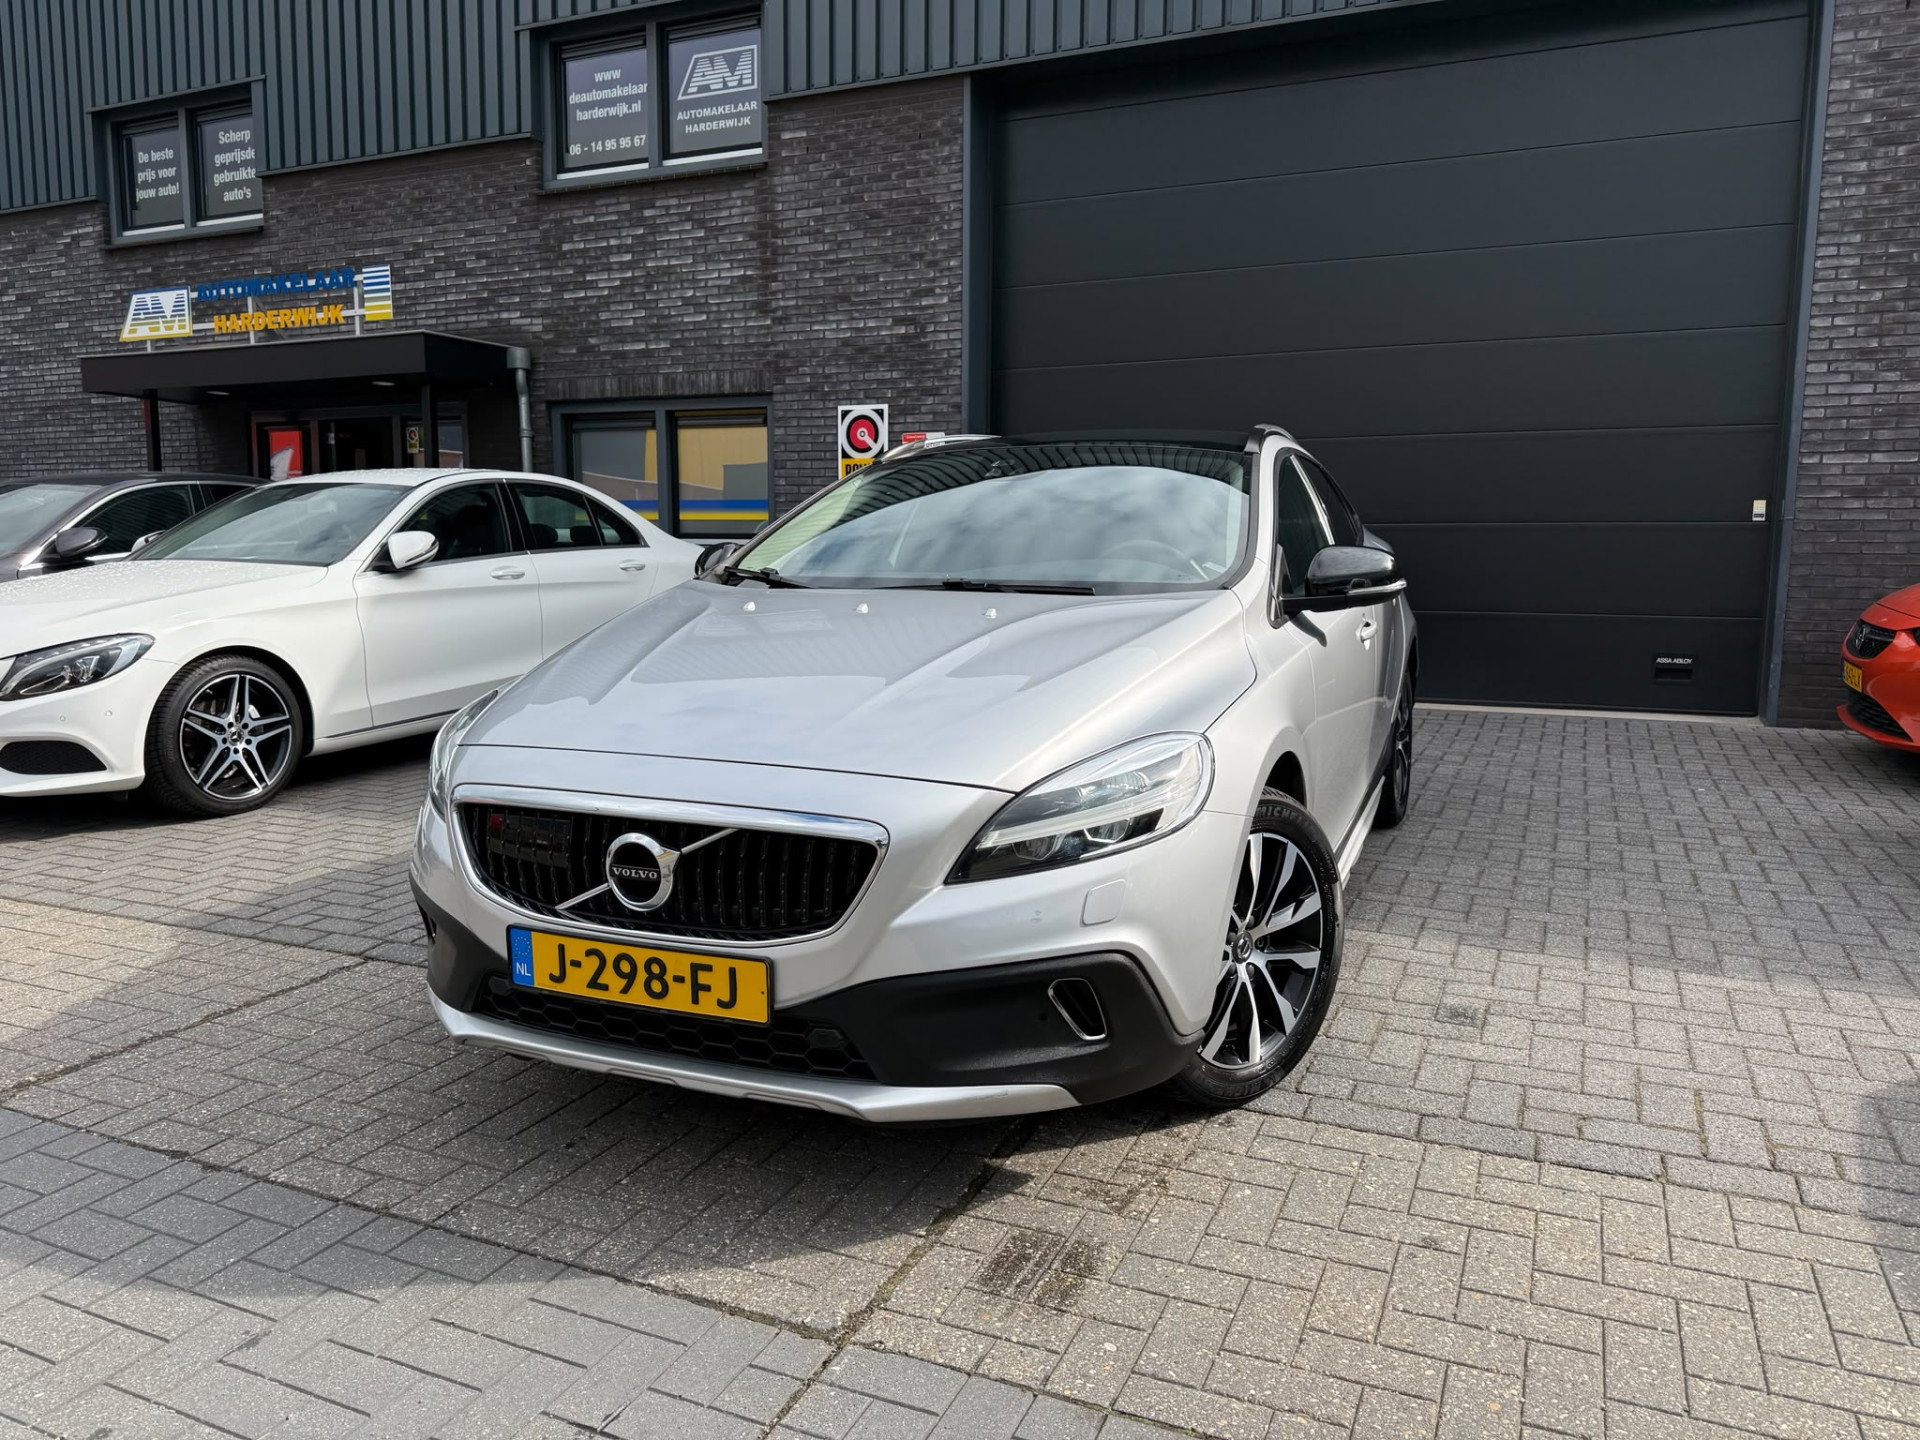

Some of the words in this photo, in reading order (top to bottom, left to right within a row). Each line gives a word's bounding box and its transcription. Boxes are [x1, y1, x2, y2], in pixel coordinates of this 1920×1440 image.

[594, 69, 621, 83] www
[569, 82, 648, 105] deautomakelaar
[576, 100, 641, 122] harderwijk.nl
[677, 101, 758, 121] AUTOMAKELAAR
[685, 116, 751, 134] HARDERWIJK
[218, 129, 251, 144] Scherp
[569, 143, 581, 156] 06
[591, 141, 602, 153] 14
[604, 139, 617, 151] 95
[619, 136, 631, 149] 95
[634, 134, 646, 147] 67
[138, 151, 149, 163] De
[151, 147, 174, 162] beste
[137, 168, 156, 184] prijs
[157, 166, 176, 178] voor
[213, 166, 256, 187] gebruikte
[136, 187, 156, 203] jouw
[158, 182, 180, 197] auto!
[223, 186, 252, 202] auto's
[196, 267, 357, 302] AUTOMAKELAAR
[213, 304, 346, 335] HARDERWIJK
[612, 866, 658, 879] VOLVO
[516, 962, 532, 977] NL
[549, 943, 738, 1010] J-298-FJ
